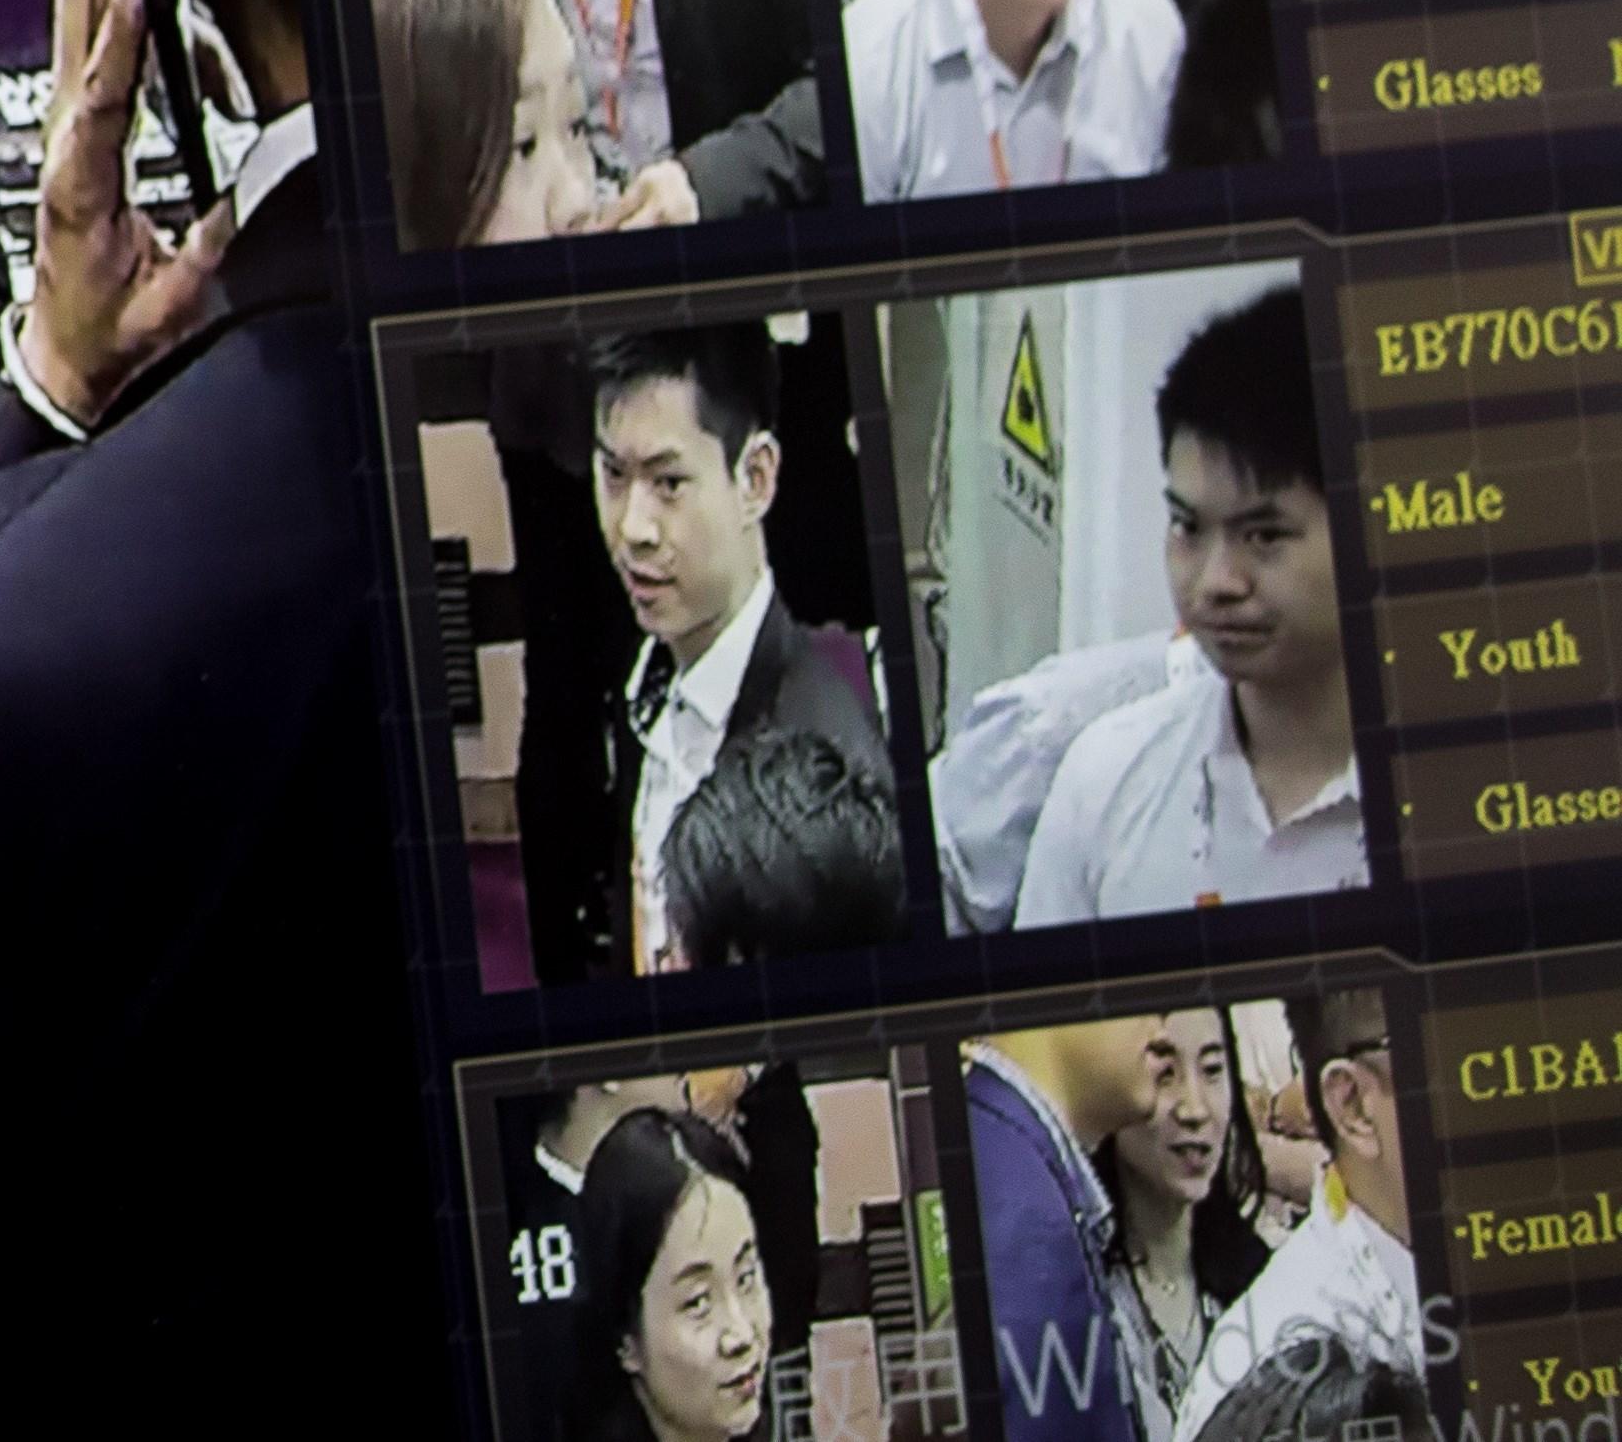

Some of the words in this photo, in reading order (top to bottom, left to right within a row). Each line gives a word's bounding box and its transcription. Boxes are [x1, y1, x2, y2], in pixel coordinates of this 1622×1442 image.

[1375, 60, 1541, 108] Glasses
[1384, 473, 1502, 531] Male
[1440, 620, 1578, 678] Youth
[1469, 1194, 1622, 1258] Femal
[1523, 1356, 1622, 1407] You
